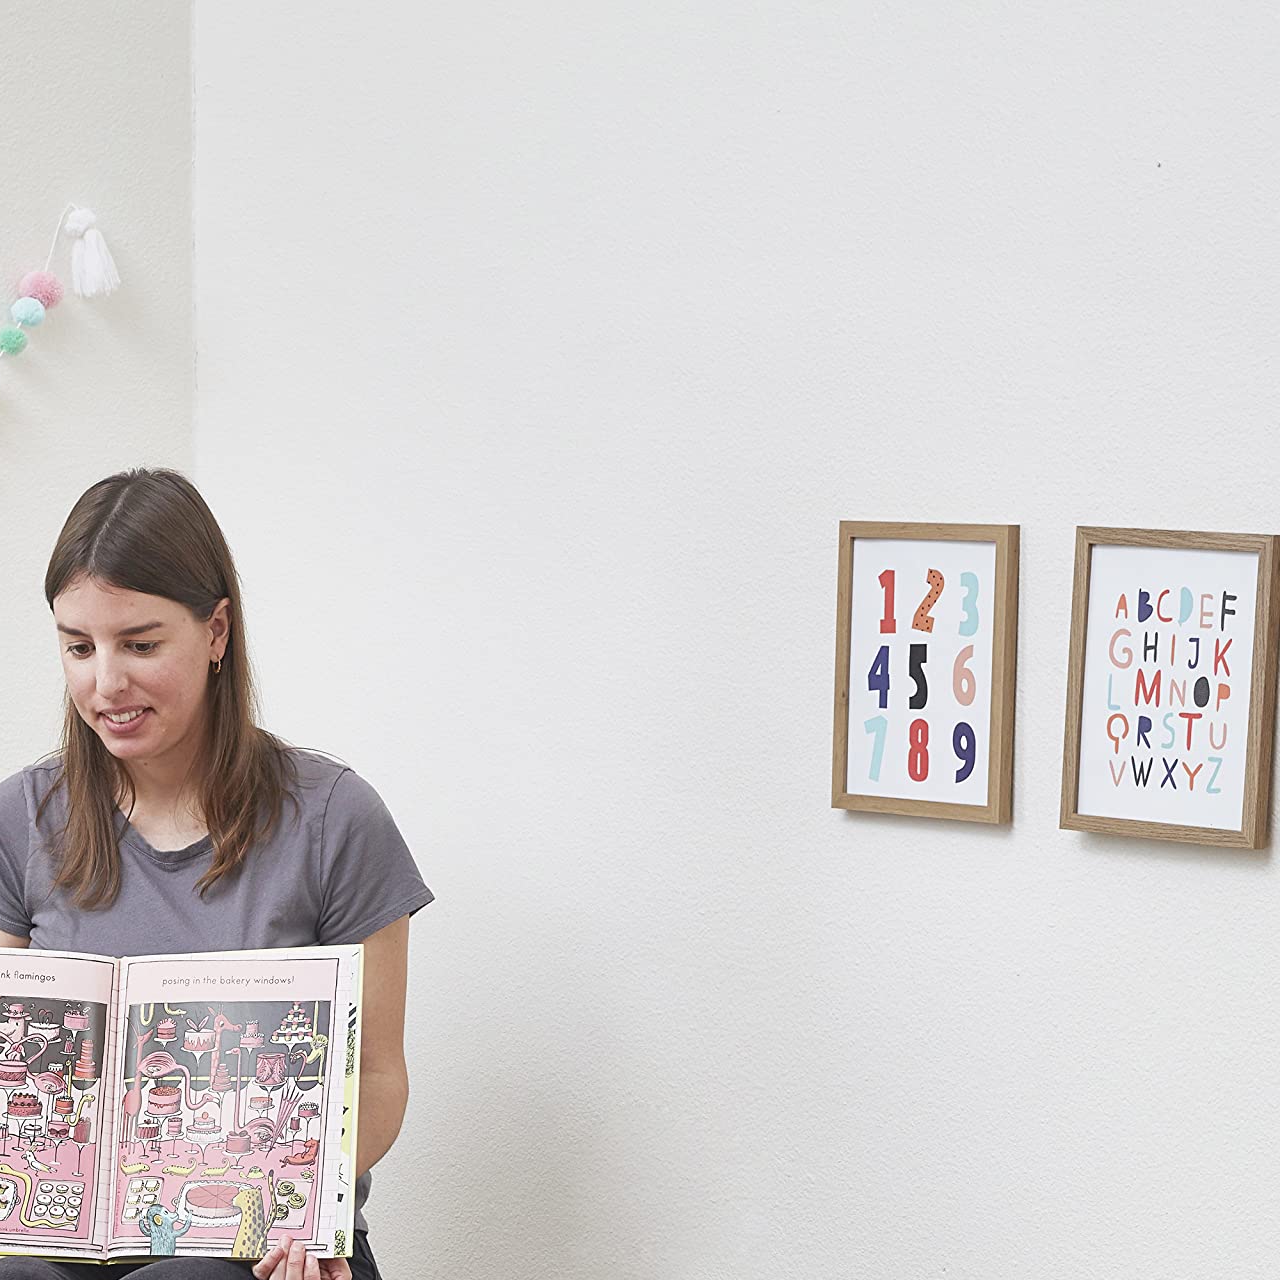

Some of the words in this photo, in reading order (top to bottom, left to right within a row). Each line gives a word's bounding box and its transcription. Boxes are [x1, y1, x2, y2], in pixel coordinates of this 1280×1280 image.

[14, 970, 56, 983] flamingos
[162, 976, 190, 987] posing
[192, 976, 201, 985] in
[202, 976, 217, 985] the
[220, 976, 251, 987] bakery
[253, 976, 295, 985] windows!
